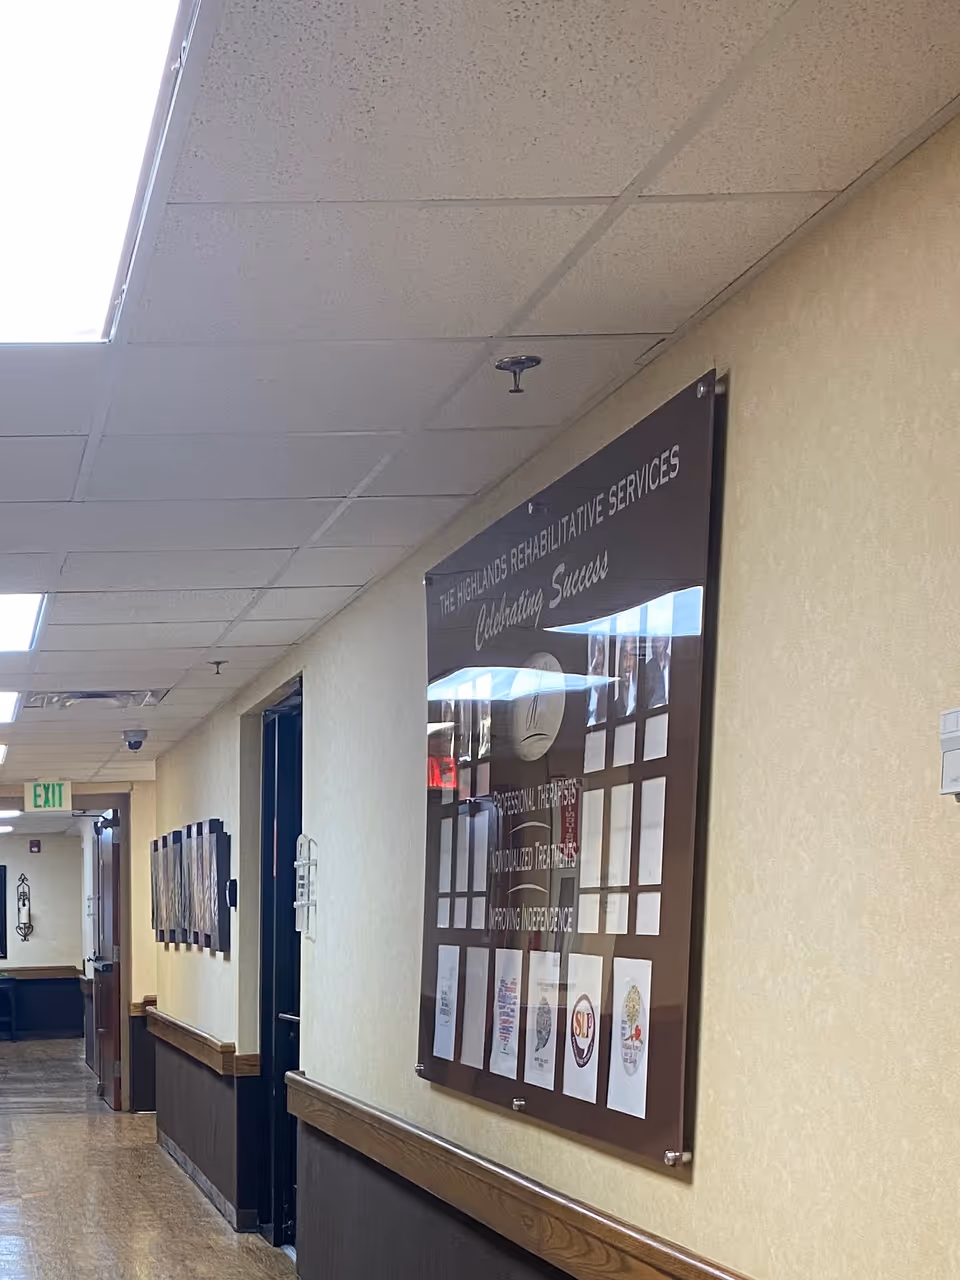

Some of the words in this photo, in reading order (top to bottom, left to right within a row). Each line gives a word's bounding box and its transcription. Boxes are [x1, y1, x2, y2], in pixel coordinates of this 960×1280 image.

[440, 585, 455, 617] THE
[457, 554, 508, 605] HIGHLANDS
[510, 493, 605, 575] REHABILITATIVE
[608, 444, 680, 516] SERVICES
[475, 586, 543, 651] Celebrating
[549, 550, 609, 609] Success
[33, 782, 64, 808] EXIT
[493, 787, 536, 817] PROFESSIONAL
[489, 904, 520, 931] IMPROVING
[521, 903, 573, 933] INDEPENDENCE
[574, 1010, 593, 1040] SLP
